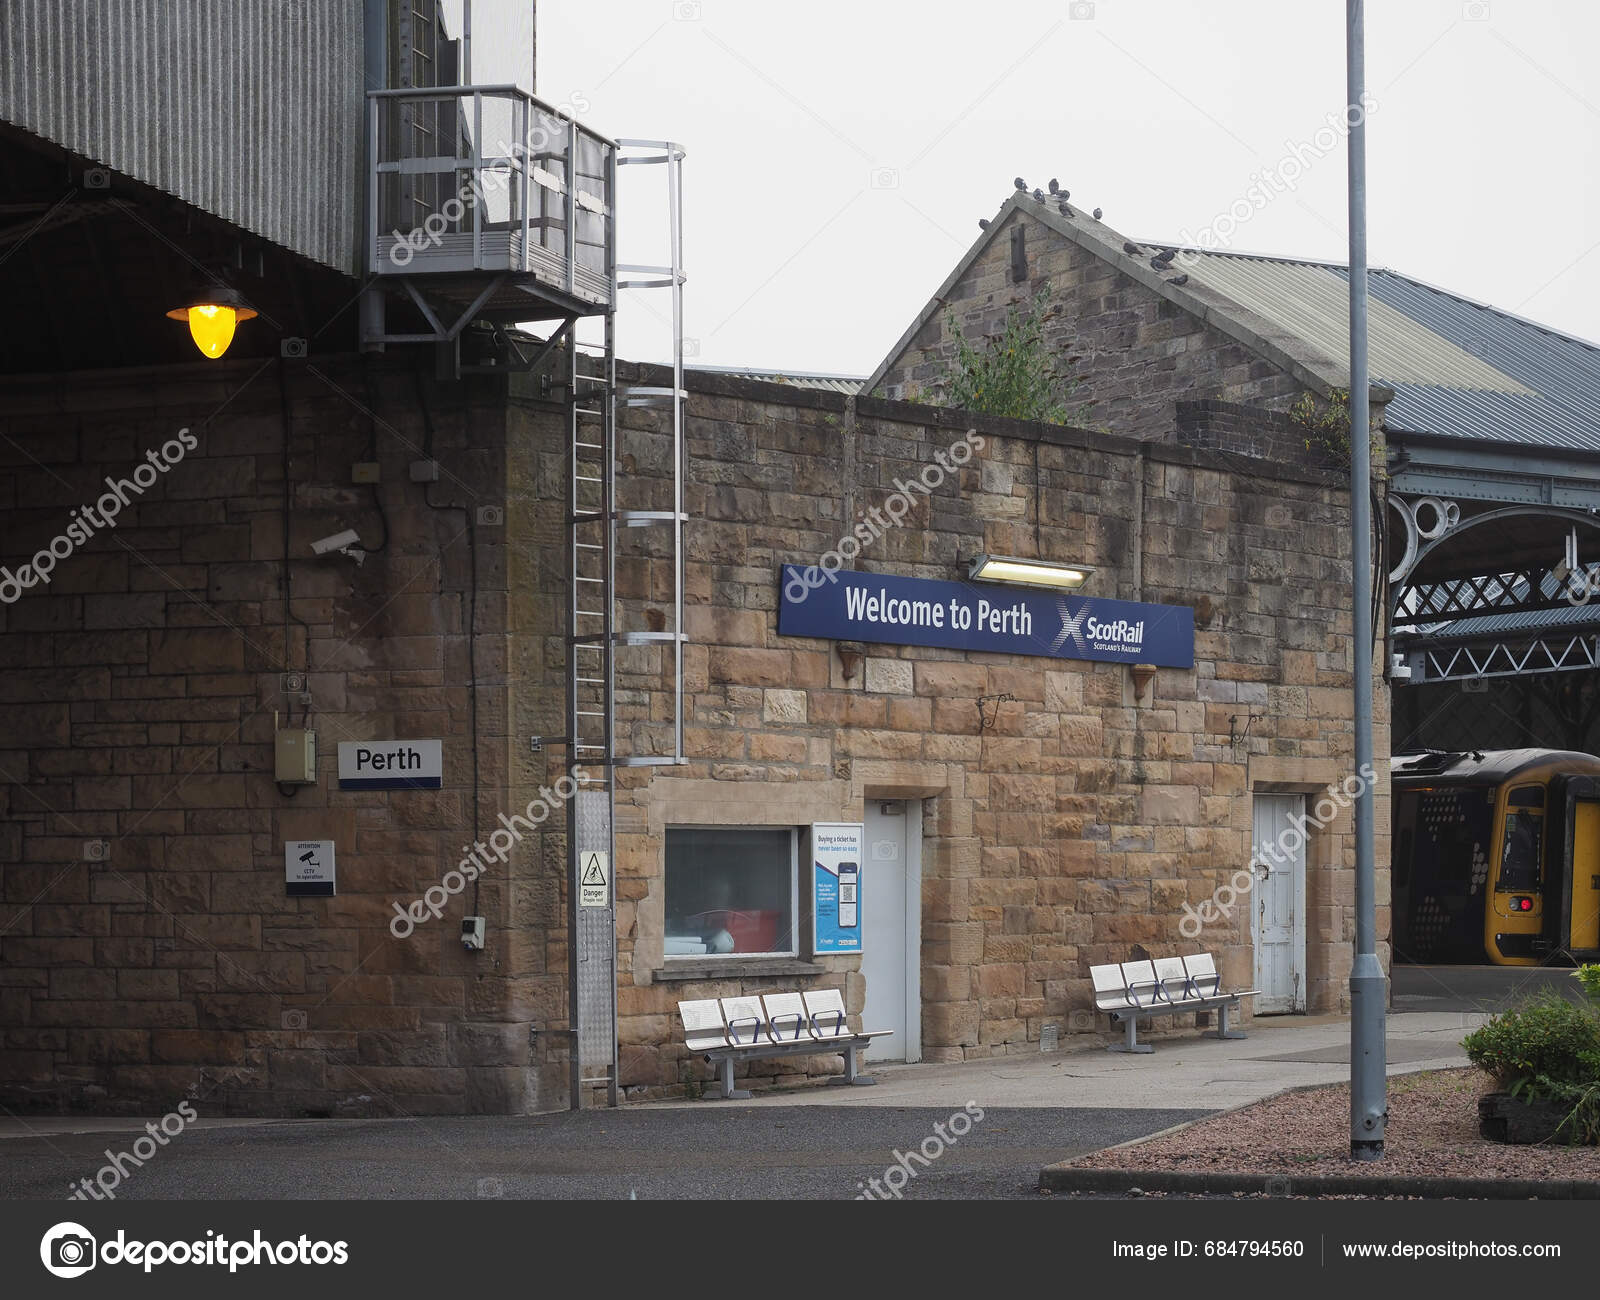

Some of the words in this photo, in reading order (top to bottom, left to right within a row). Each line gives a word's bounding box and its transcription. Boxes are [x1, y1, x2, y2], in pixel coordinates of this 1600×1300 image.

[845, 586, 944, 628] Welcome
[949, 598, 970, 631] to
[978, 600, 1033, 637] Perth
[1086, 616, 1145, 644] ScotRail
[1121, 644, 1142, 654] RAILWAY
[356, 747, 421, 771] Perth
[818, 835, 833, 844] Buying
[583, 889, 603, 898] Danger
